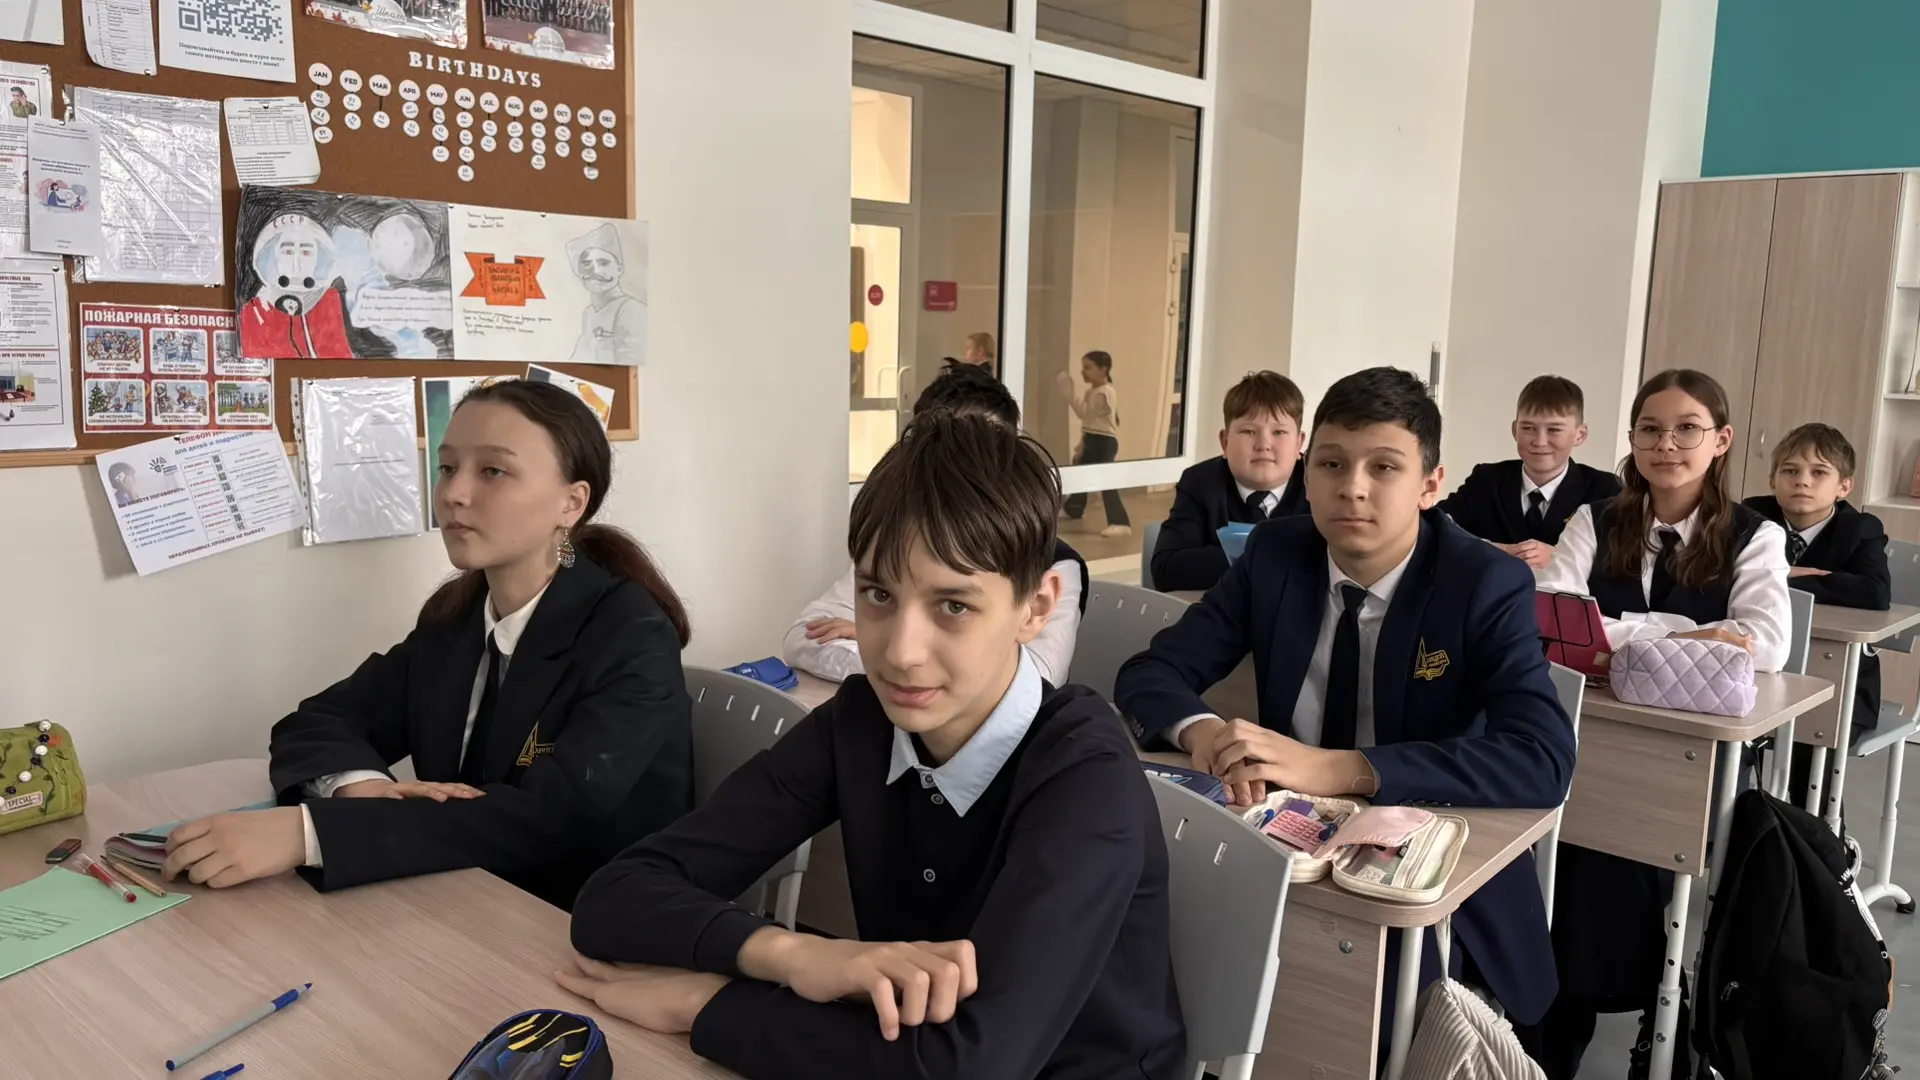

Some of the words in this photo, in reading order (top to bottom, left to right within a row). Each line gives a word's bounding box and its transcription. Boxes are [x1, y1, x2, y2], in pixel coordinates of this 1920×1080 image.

[408, 51, 542, 88] BIRTHDAYS
[372, 82, 388, 90] MAR
[84, 309, 161, 324] ПОЖАРНАЯ
[164, 312, 234, 327] БЕЗОПАСН
[178, 431, 211, 444] ТЕЛЕФОН
[188, 442, 208, 452] детей
[8, 795, 32, 807] SPECIAL
